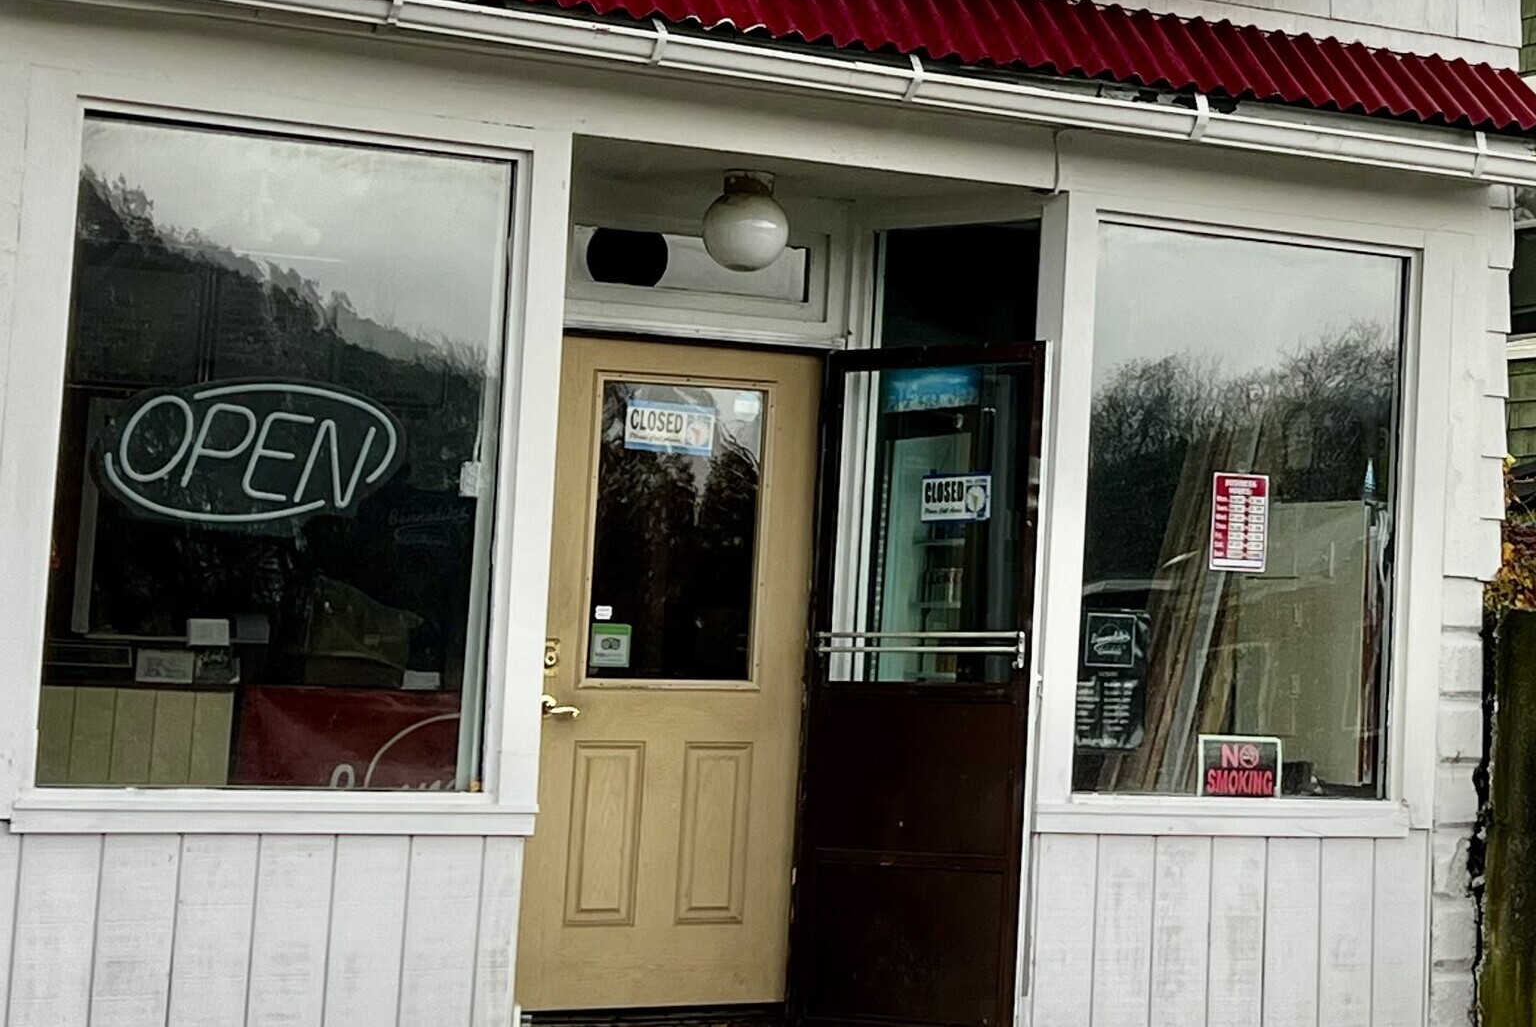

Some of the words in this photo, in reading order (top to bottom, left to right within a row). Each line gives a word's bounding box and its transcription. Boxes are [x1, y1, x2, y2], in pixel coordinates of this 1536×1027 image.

[630, 409, 683, 434] CLOSED
[120, 394, 377, 509] OPEN
[925, 481, 964, 504] CLOSED
[1221, 744, 1260, 769] NO
[1206, 769, 1273, 795] SMOKING
